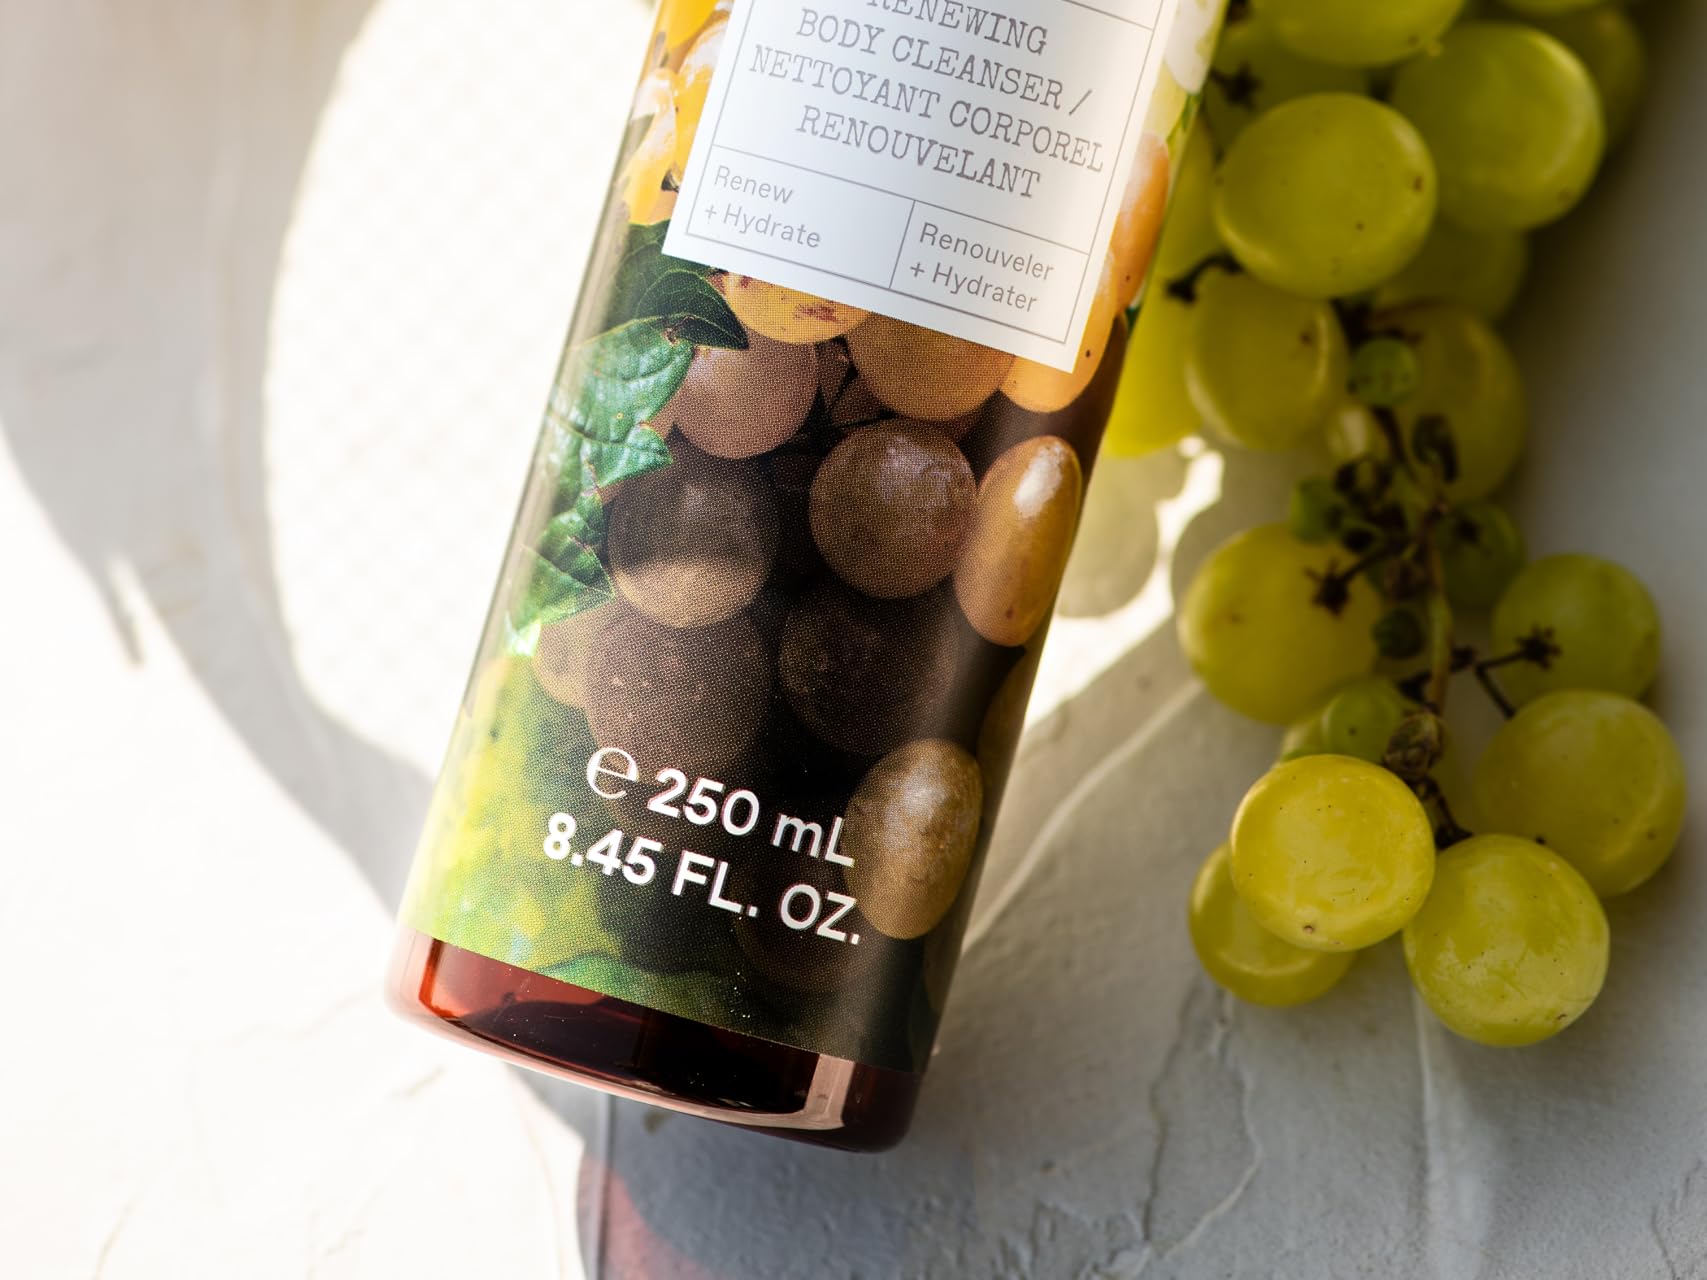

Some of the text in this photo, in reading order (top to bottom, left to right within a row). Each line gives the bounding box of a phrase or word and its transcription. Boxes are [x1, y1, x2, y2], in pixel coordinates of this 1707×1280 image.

[796, 9, 884, 55] BODY
[893, 34, 1063, 110] CLEANSER
[749, 45, 1105, 172] NETTOYANT CORPOREL
[796, 105, 1041, 199] RENOUVELANT
[714, 165, 793, 204] Renew
[721, 204, 822, 249] Hydrate
[919, 223, 1055, 282] Renouveler
[932, 265, 1038, 313] Hydrater
[647, 768, 760, 836] 250
[772, 813, 855, 867] mL
[543, 812, 860, 945] 8.45 FL. OZ.
